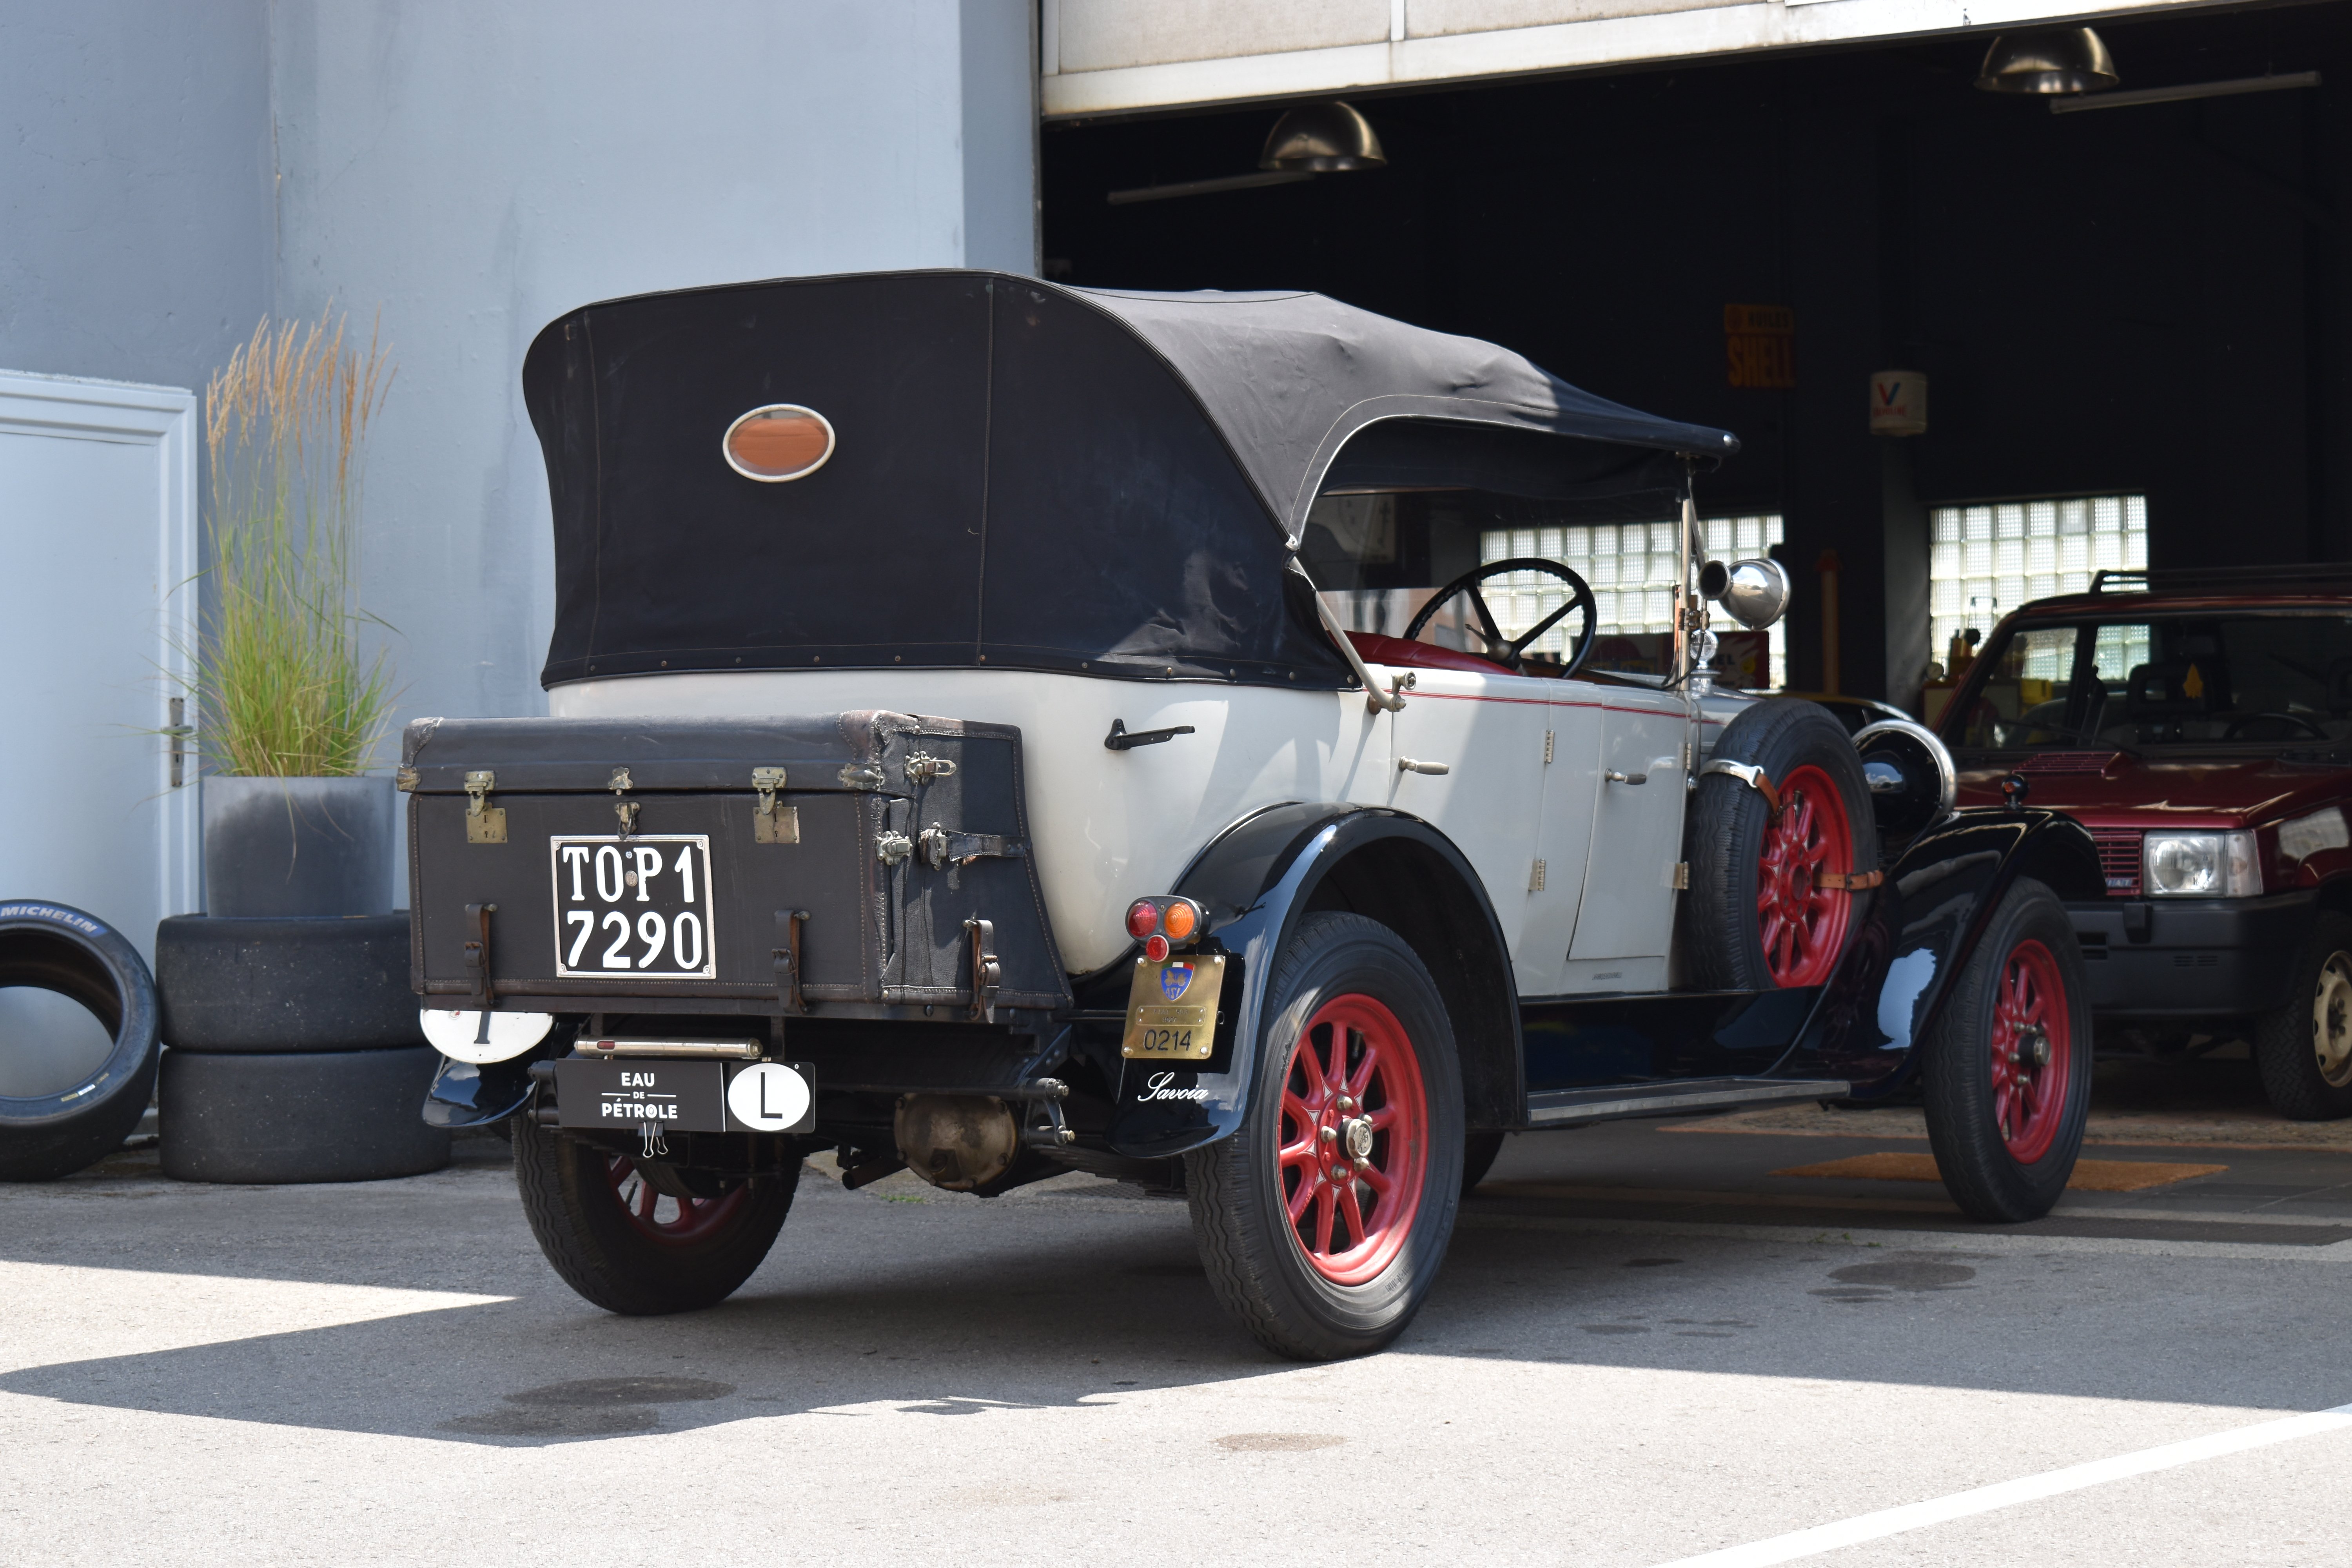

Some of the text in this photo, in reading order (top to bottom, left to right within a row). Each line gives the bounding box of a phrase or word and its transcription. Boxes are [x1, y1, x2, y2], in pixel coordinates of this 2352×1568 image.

[1748, 311, 1788, 328] HUILES
[1728, 336, 1795, 387] SHELL
[1, 906, 98, 933] MICHELIN
[567, 911, 702, 969] 7290
[1143, 1029, 1191, 1051] 0214
[621, 1072, 655, 1087] EAU
[1138, 1072, 1209, 1101] Savoia
[602, 1098, 678, 1119] PÉTROLE
[760, 1072, 782, 1119] L
